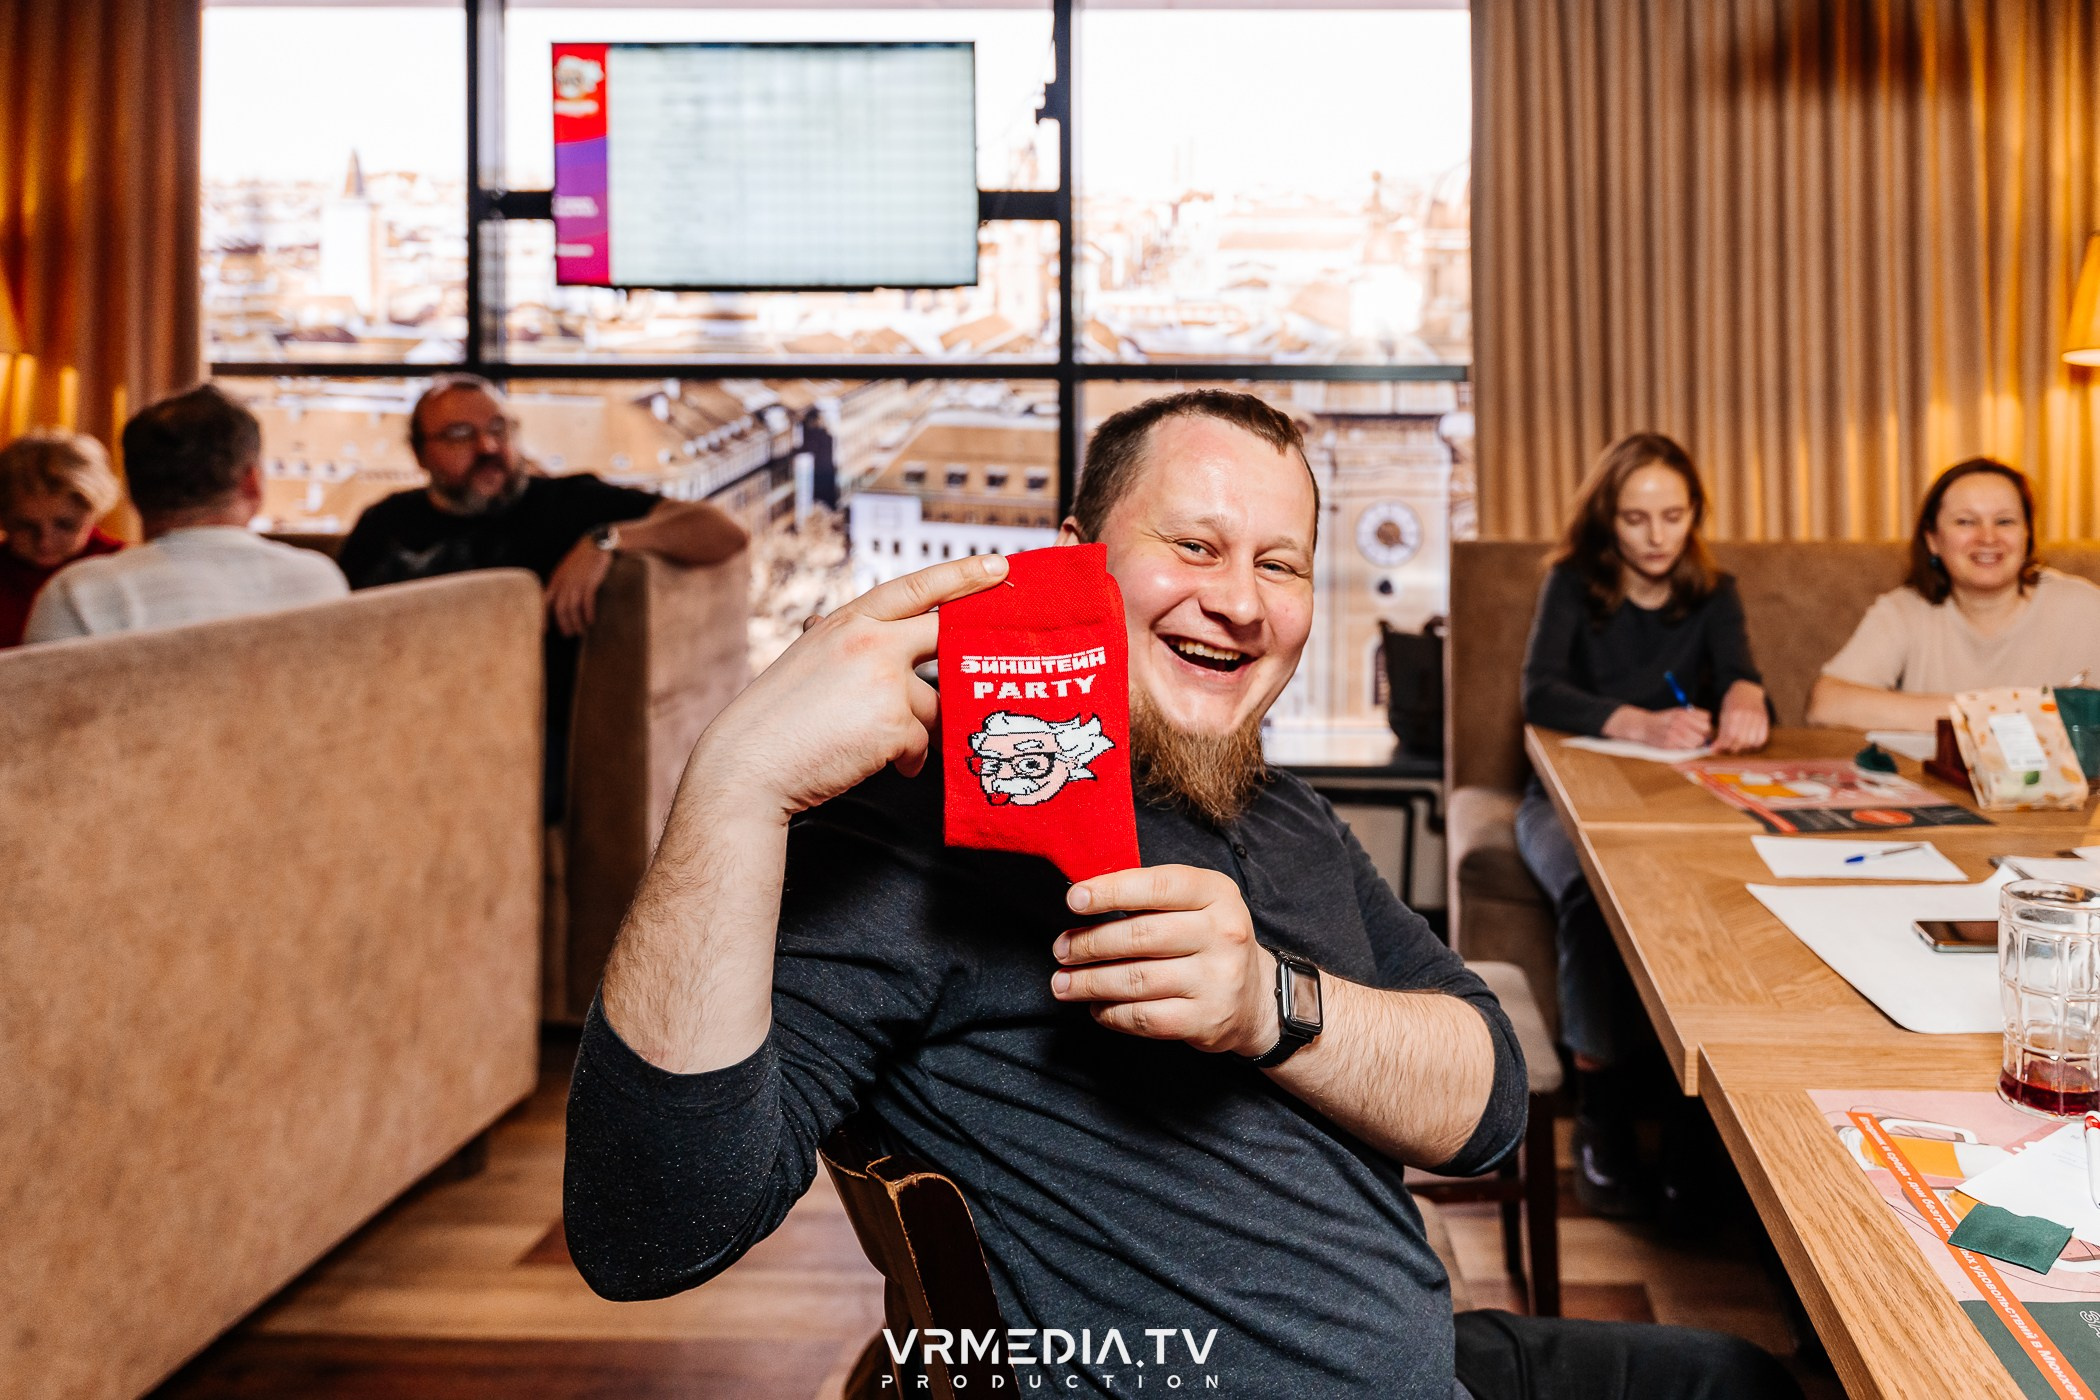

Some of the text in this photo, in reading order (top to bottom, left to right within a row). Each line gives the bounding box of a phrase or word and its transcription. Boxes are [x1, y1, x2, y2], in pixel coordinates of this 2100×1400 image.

[973, 674, 1097, 699] PARTY
[1886, 1152, 1911, 1177] среда
[1907, 1180, 1927, 1198] дни
[1969, 1264, 2039, 1339] удовольствий
[2030, 1340, 2043, 1349] в
